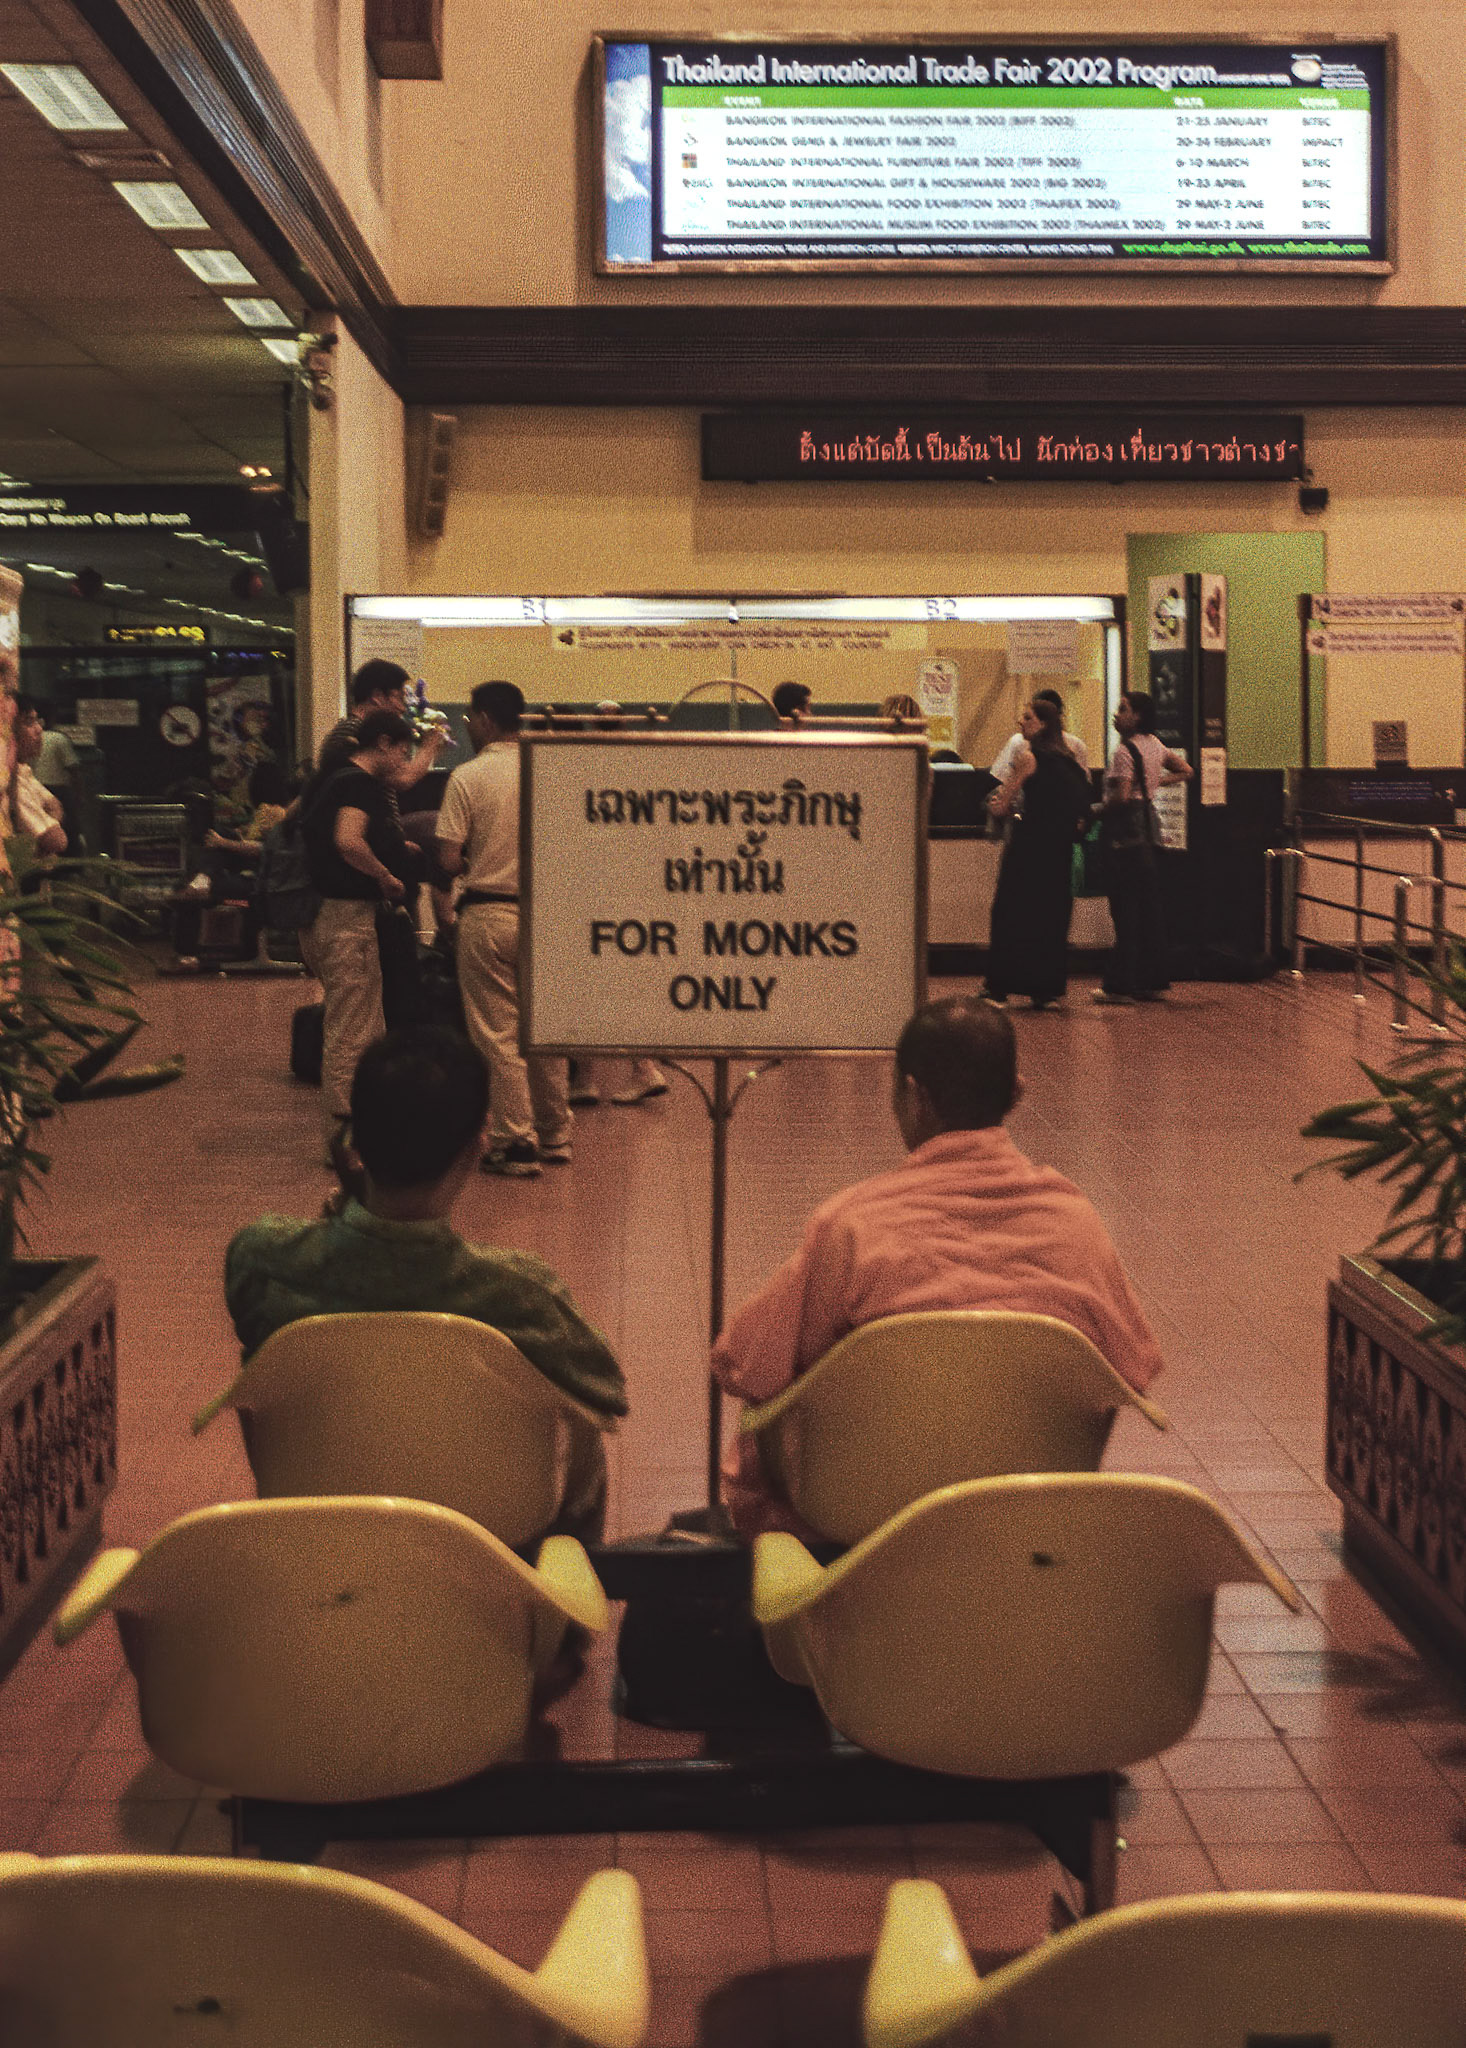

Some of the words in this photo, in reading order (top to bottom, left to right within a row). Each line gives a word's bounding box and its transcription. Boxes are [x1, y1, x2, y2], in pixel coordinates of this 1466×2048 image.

[662, 55, 766, 84] Thailand
[771, 55, 918, 84] International
[922, 56, 990, 84] Trade
[994, 57, 1043, 85] Fair
[1047, 58, 1112, 84] 2002
[1117, 58, 1217, 91] Program
[726, 115, 787, 127] BANGKOK
[792, 115, 886, 127] INTERNATIONAL
[889, 115, 943, 127] FASHION
[946, 115, 972, 127] FAIR
[976, 115, 1006, 127] 2002
[1214, 115, 1268, 127] JANUARY
[726, 136, 787, 147] BANGKOK
[896, 136, 922, 147] FAIR
[926, 136, 957, 147] 2002
[1214, 136, 1271, 147] FEBRUARY
[1302, 137, 1343, 147] IMPACT
[727, 157, 786, 168] THAILAND
[791, 157, 883, 168] INTERNATIONAL
[887, 157, 951, 168] FURNITURE
[954, 157, 980, 168] FAIR
[984, 157, 1014, 168] 2002
[1206, 157, 1249, 168] MARCH
[727, 178, 787, 189] BANGKOK
[792, 178, 886, 189] INTERNATIONAL
[890, 178, 914, 189] GIFT
[1010, 178, 1040, 189] 2002
[1214, 178, 1246, 189] APRIL
[727, 199, 786, 210] THAILAND
[790, 199, 883, 210] INTERNATIONAL
[887, 199, 922, 210] FOOD
[925, 199, 993, 210] EXHIBITION
[997, 199, 1027, 210] 2002
[1235, 199, 1265, 210] JUNE
[727, 219, 786, 231] THAILAND
[789, 219, 884, 231] INTERNATIONAL
[936, 219, 969, 231] FOOD
[973, 219, 1038, 231] EXHIBITION
[1041, 219, 1071, 231] 2002
[1235, 219, 1265, 231] JUNE
[925, 599, 957, 620] B2
[584, 777, 863, 841] เฉพาะพระภิกษุ
[664, 830, 785, 894] เท่านั้น
[590, 919, 677, 957] FOR
[703, 919, 859, 957] MONKS
[669, 974, 777, 1012] ONLY
